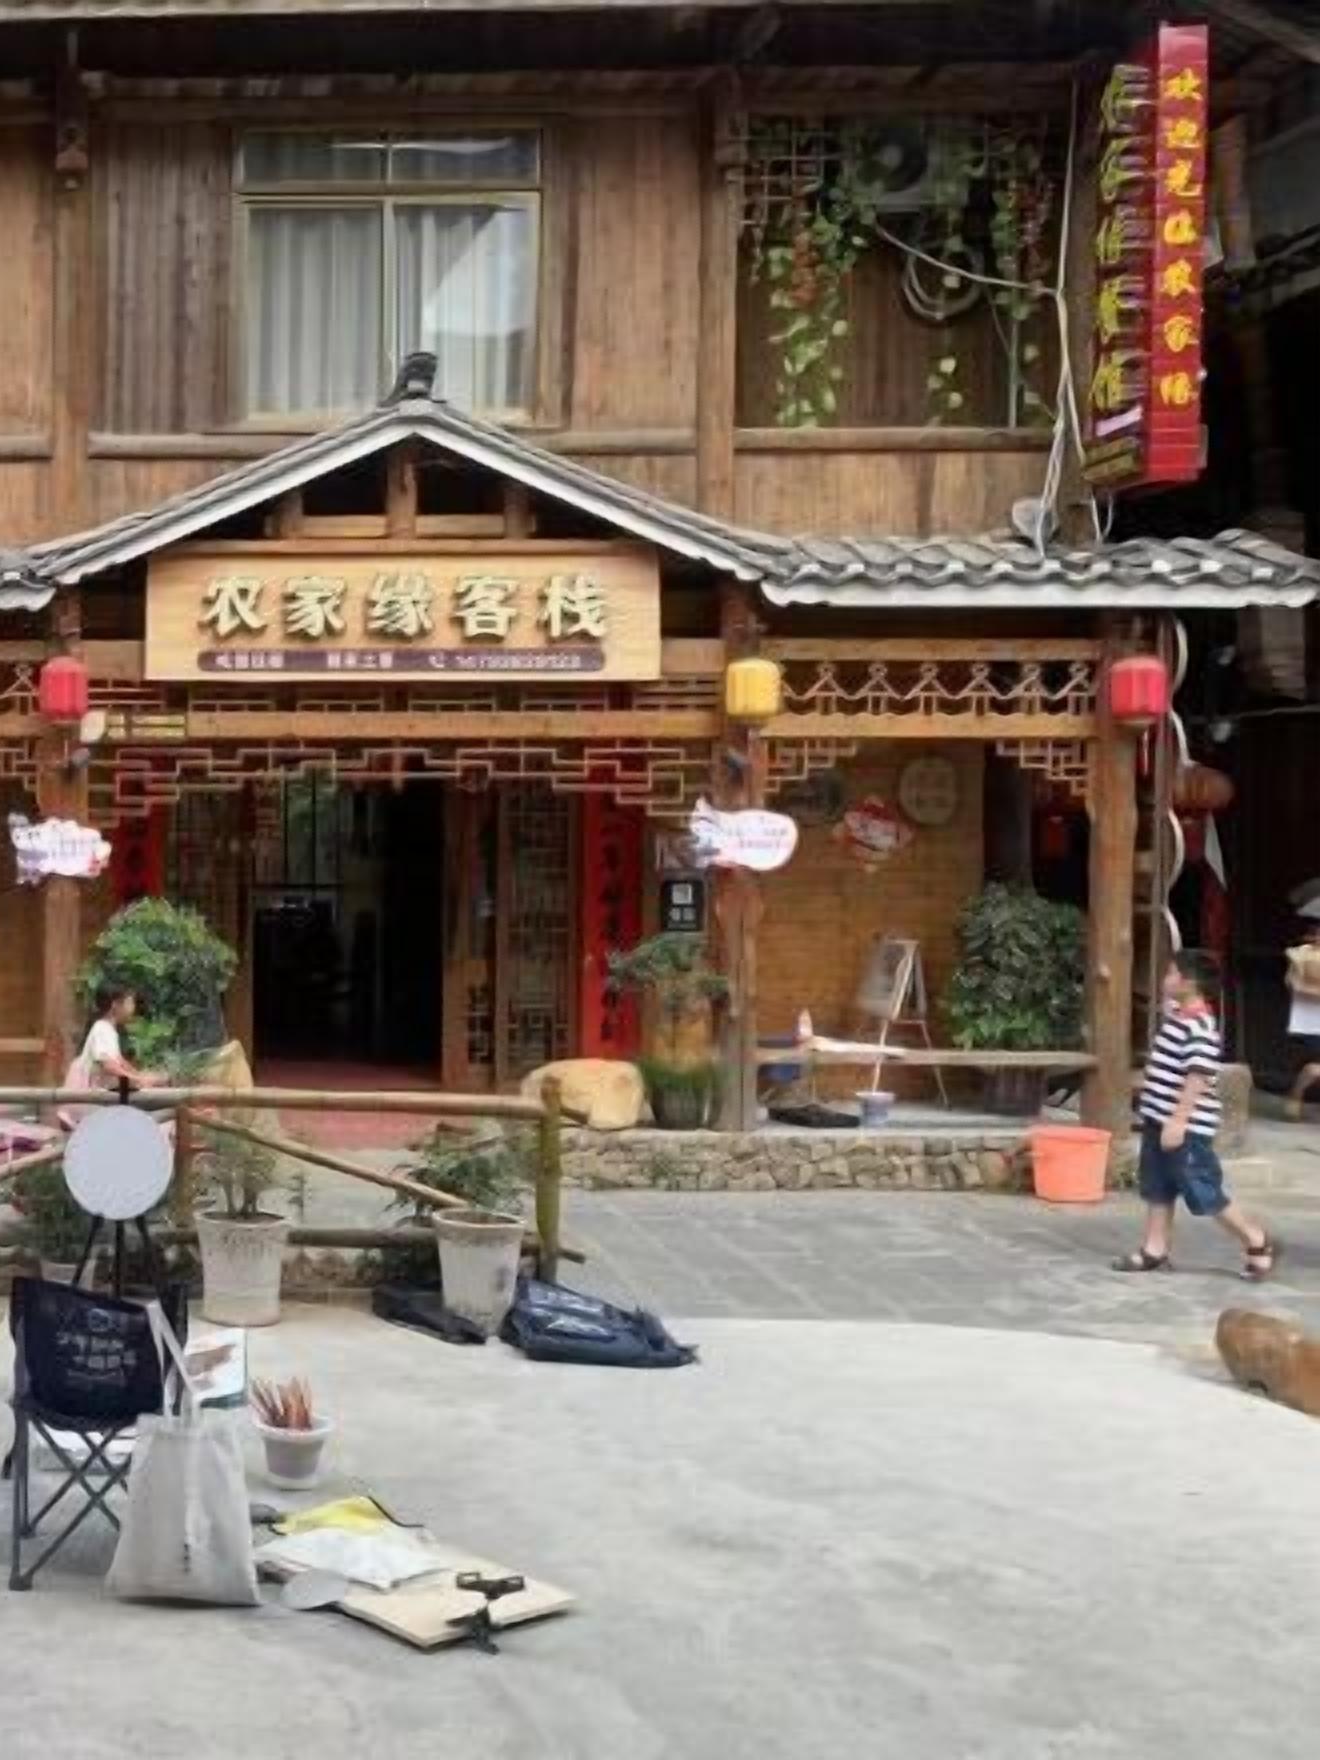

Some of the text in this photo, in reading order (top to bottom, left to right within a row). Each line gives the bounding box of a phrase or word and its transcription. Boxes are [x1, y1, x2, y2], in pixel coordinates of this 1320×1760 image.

[202, 573, 609, 639] 农家缘客栈
